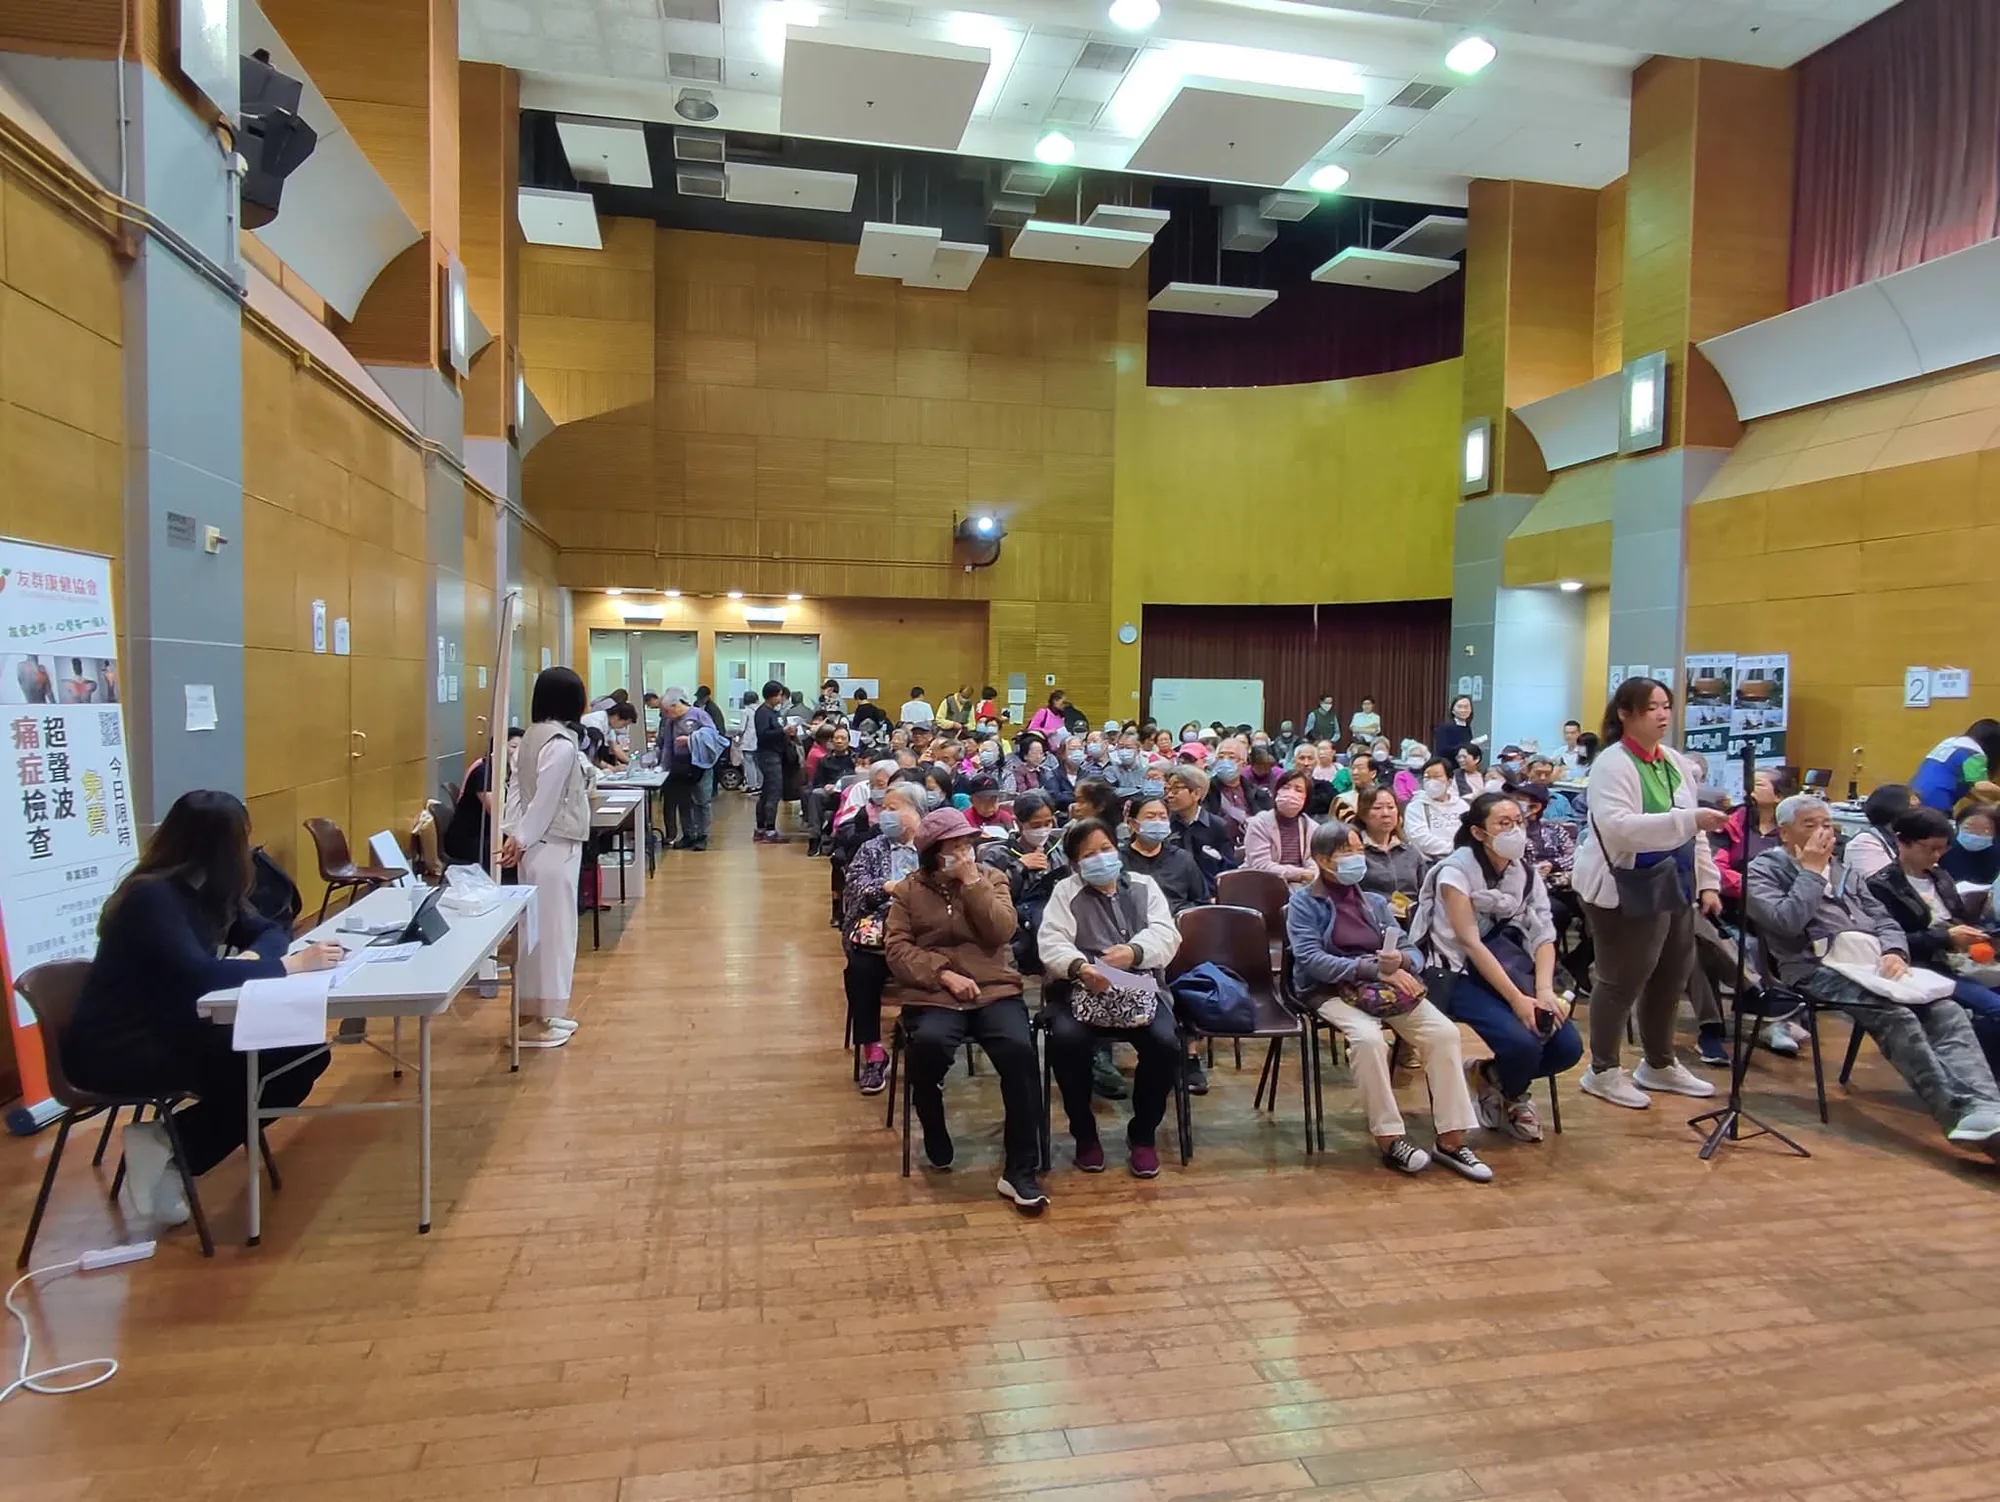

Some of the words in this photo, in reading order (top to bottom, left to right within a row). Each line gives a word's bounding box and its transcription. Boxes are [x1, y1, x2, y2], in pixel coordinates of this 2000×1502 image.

[16, 569, 97, 596] 友群康健協會
[1909, 678, 1925, 702] 2
[10, 715, 53, 860] 痛症檢查
[43, 715, 76, 821] 超聲波
[80, 768, 110, 837] 免費
[109, 755, 131, 847] 今日限時
